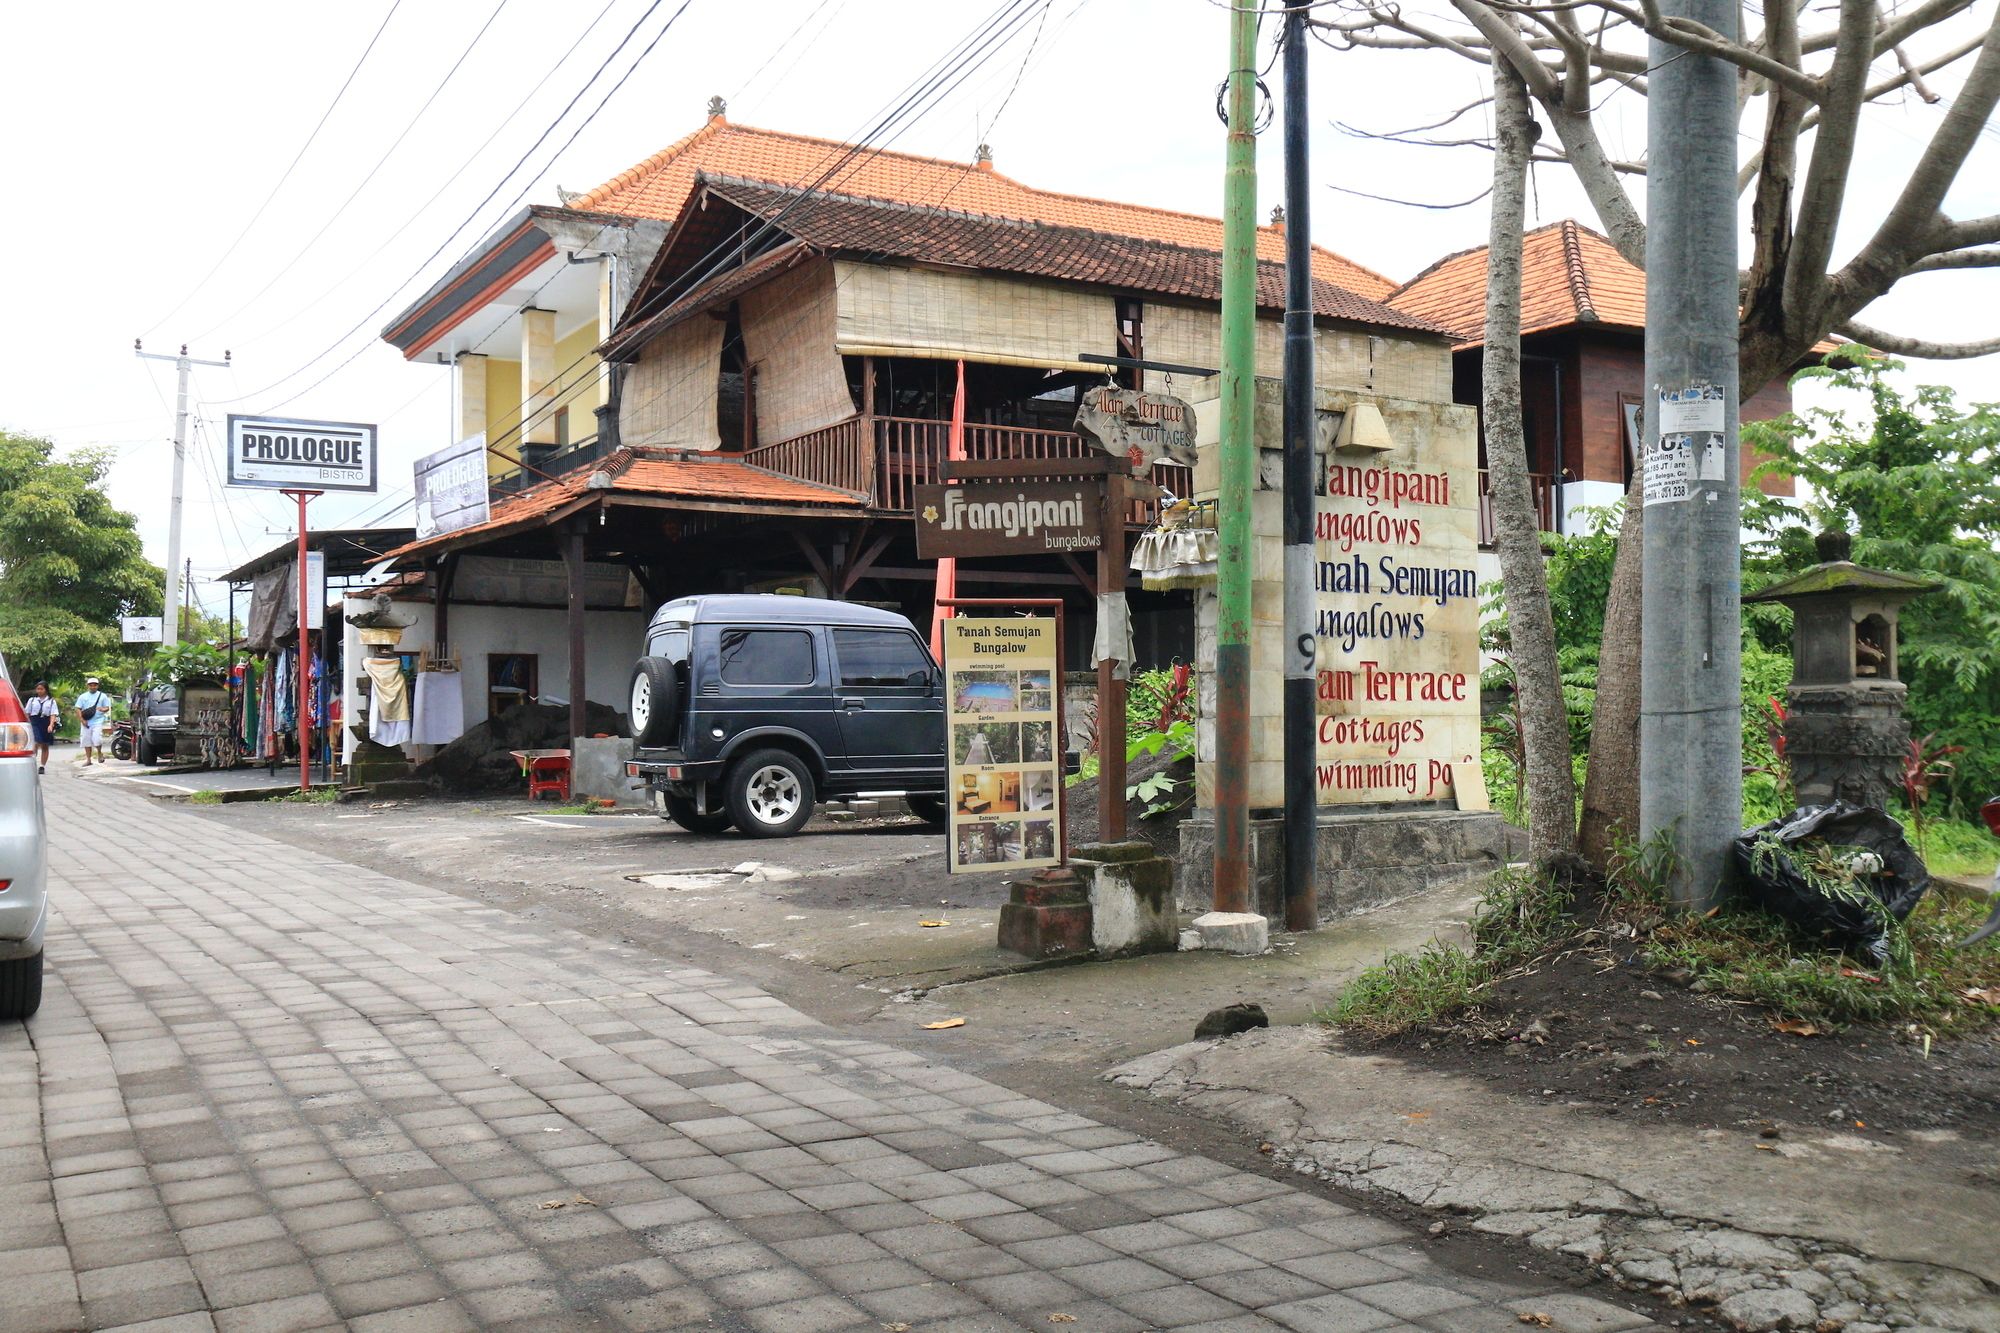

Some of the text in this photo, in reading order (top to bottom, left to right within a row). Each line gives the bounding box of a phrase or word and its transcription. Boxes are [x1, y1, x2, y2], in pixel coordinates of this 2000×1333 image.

[1135, 395, 1183, 423] Terrace
[242, 434, 362, 464] PROLOGUE
[1141, 427, 1192, 447] COTTAGES
[322, 470, 364, 481] BISTRO
[426, 457, 483, 498] PROLOGUE
[1329, 464, 1449, 509] angipani
[941, 488, 1084, 538] Frangipani
[1315, 511, 1421, 552] ungalows
[1045, 529, 1101, 552] bungalows
[1315, 554, 1477, 607] nah Semujan
[957, 626, 1041, 639] Tanah Semujan
[1315, 602, 1425, 653] ungalows
[973, 642, 1027, 655] Bungalow
[1317, 661, 1467, 703] am Terrace
[1319, 715, 1424, 757] Cottages
[1315, 760, 1418, 795] wimming
